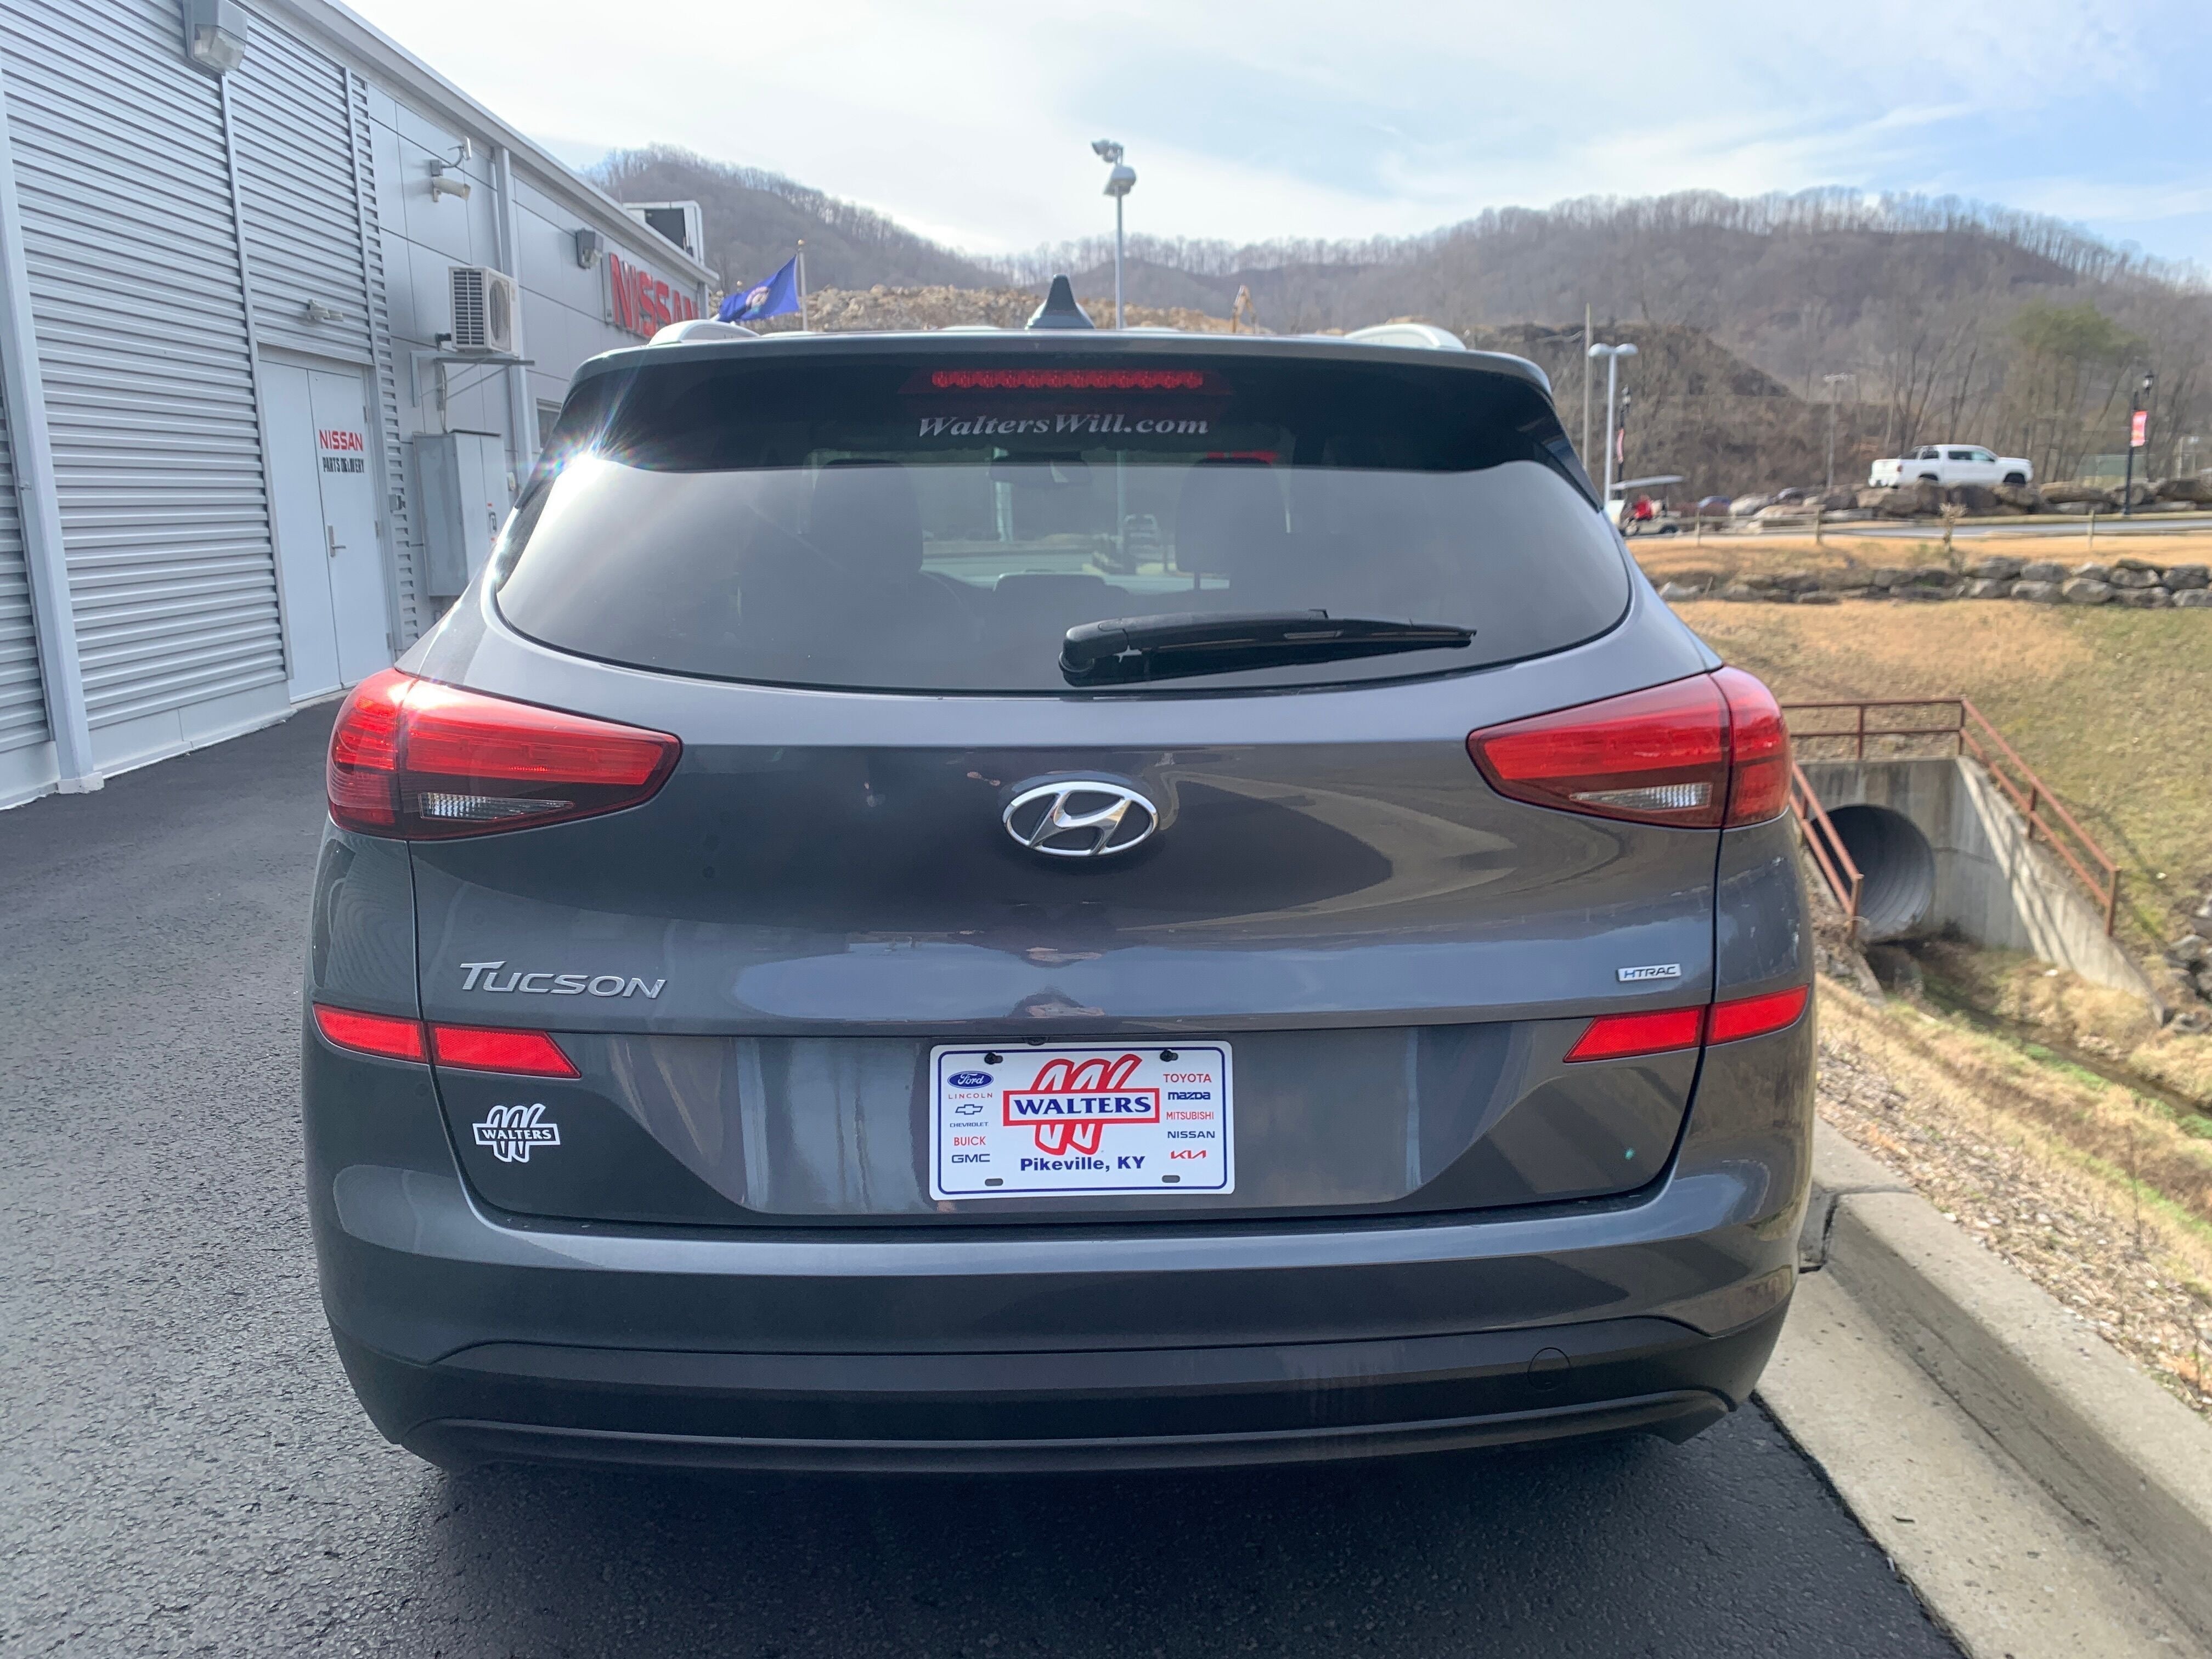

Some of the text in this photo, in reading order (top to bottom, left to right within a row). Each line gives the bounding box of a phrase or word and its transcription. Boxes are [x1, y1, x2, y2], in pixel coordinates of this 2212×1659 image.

[918, 414, 1209, 437] WaltersWill.com
[319, 429, 363, 452] NISSAN
[322, 456, 340, 472] PARTS
[1624, 966, 1677, 979] HTRAC
[957, 1073, 984, 1085] Ford
[1163, 1074, 1212, 1083] TOYOTA
[1014, 1096, 1152, 1115] WALTERS
[1166, 1111, 1214, 1120] MITSUBISHI
[481, 1129, 551, 1139] WALTERS
[1167, 1131, 1215, 1139] NISSAN
[953, 1136, 986, 1146] BUICK
[952, 1154, 990, 1164] GMC
[1171, 1150, 1206, 1159] KIA
[1020, 1155, 1146, 1172] Pikeville, KY
